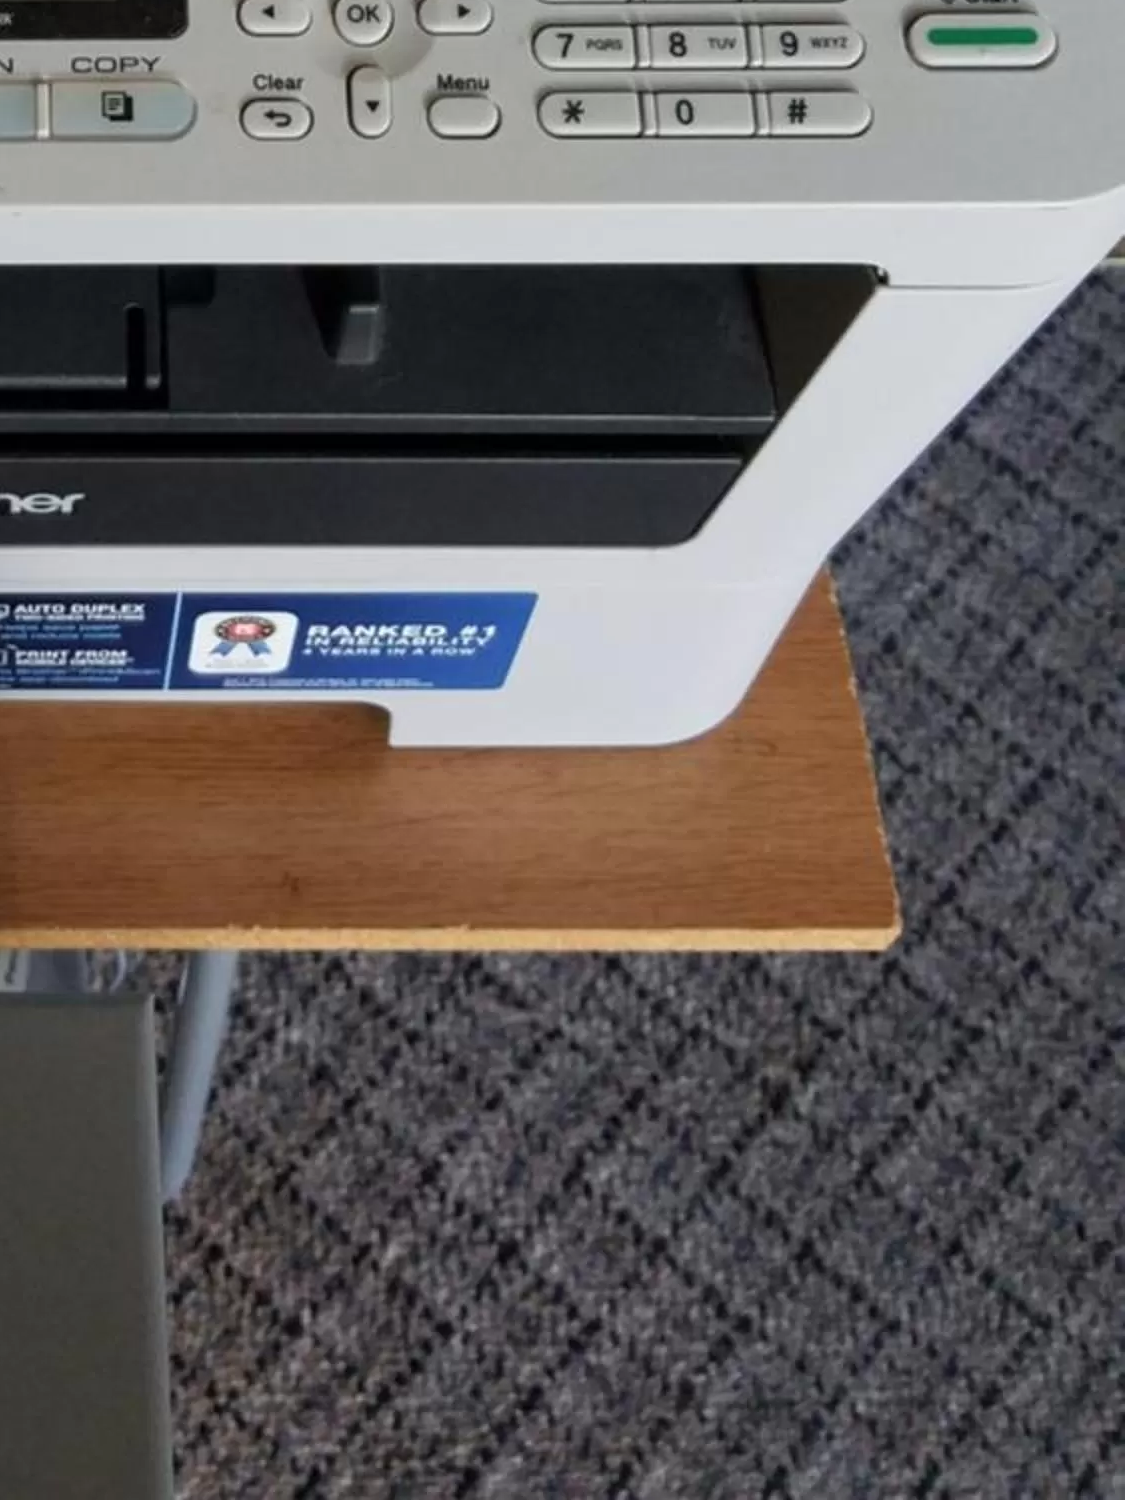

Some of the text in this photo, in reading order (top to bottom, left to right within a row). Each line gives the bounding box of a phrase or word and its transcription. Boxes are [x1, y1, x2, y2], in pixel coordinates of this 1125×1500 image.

[346, 5, 381, 23] OK
[556, 33, 574, 58] 7
[669, 32, 687, 57] 8
[779, 31, 799, 56] 9
[71, 56, 161, 74] COPY
[252, 74, 304, 91] Clear
[436, 74, 490, 91] Menu
[675, 100, 694, 125] 0
[787, 99, 808, 124] #
[14, 604, 145, 614] AUTO DUPLEX
[308, 624, 498, 639] RANKED #1
[305, 637, 491, 648] IN RELIABILITY
[317, 648, 381, 656] YEARS
[386, 648, 409, 656] IN
[413, 648, 424, 656] A
[430, 648, 477, 656] ROW
